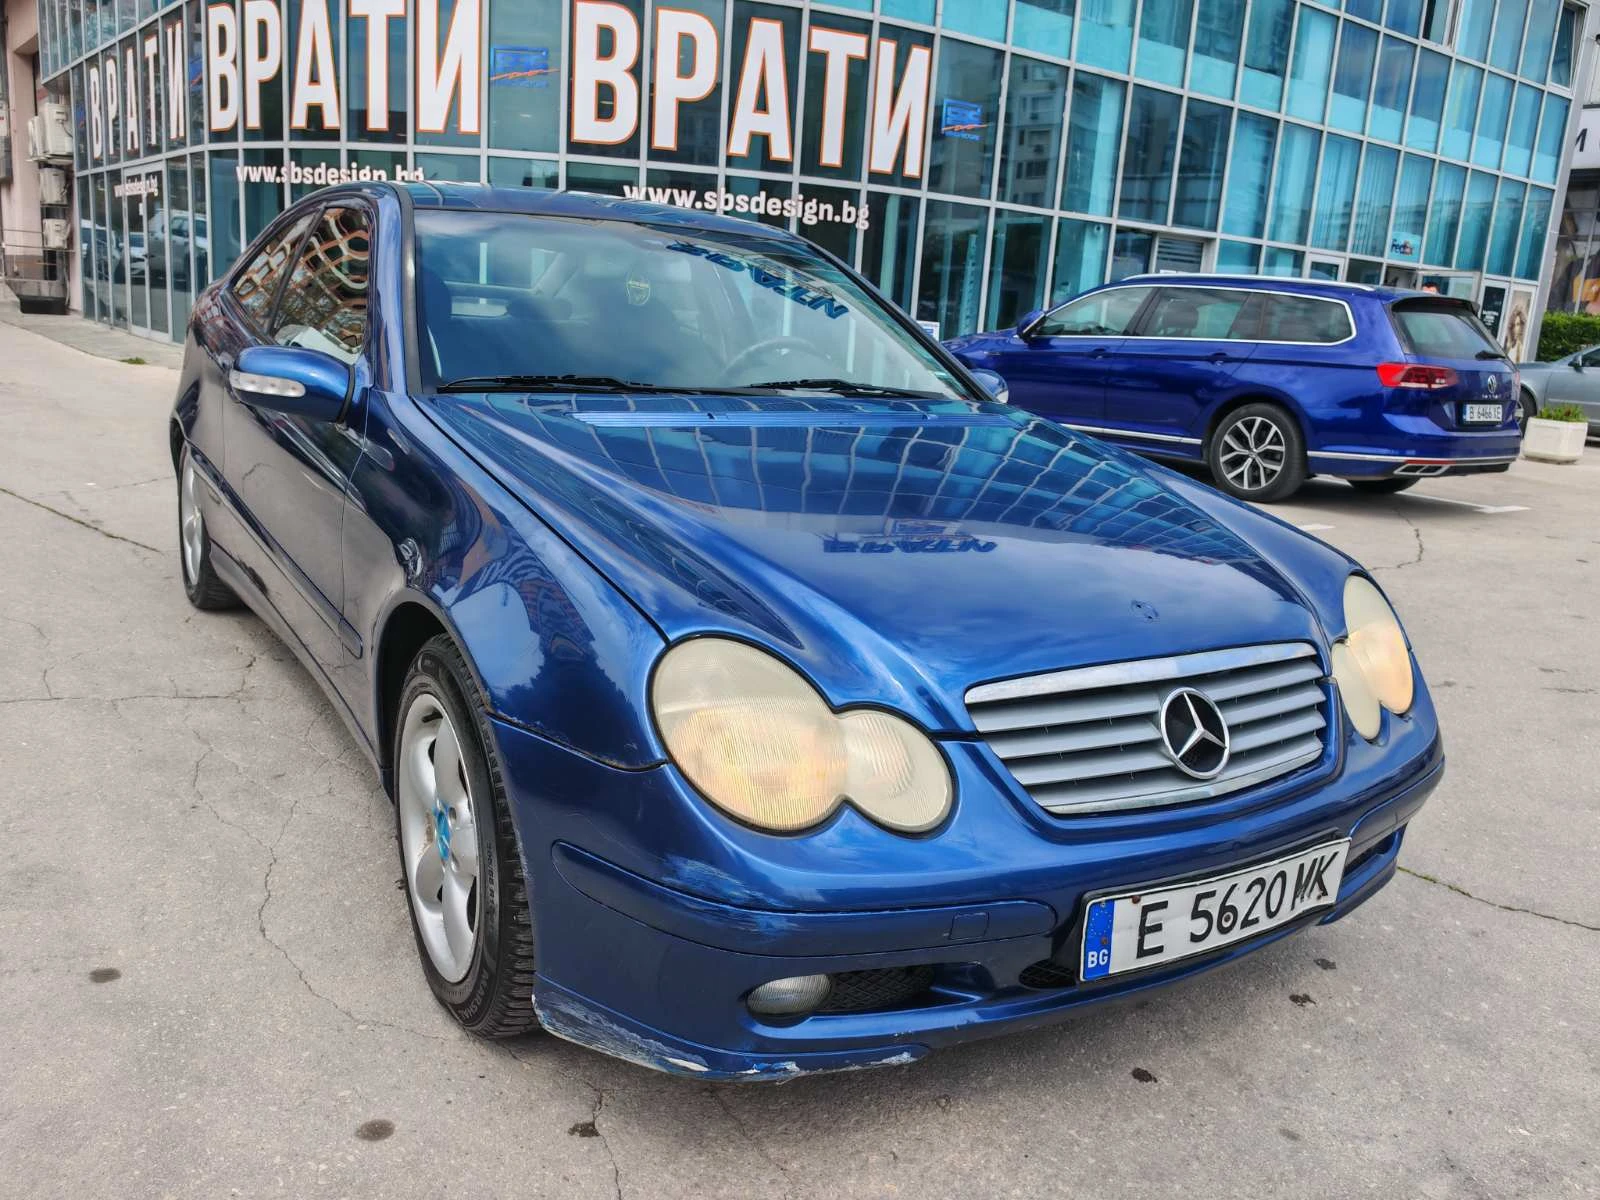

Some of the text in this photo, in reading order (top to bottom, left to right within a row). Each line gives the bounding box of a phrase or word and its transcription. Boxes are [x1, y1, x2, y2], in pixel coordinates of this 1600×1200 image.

[89, 20, 185, 160] ВРАТИ
[207, 0, 481, 135] ВРАТИ
[570, 0, 932, 179] ВРАТИ
[235, 161, 425, 185] www.sbsdesignbg
[623, 184, 870, 231] www.sbsdesign.bg
[1087, 949, 1108, 968] BG
[1136, 851, 1339, 959] E 5620 MK
